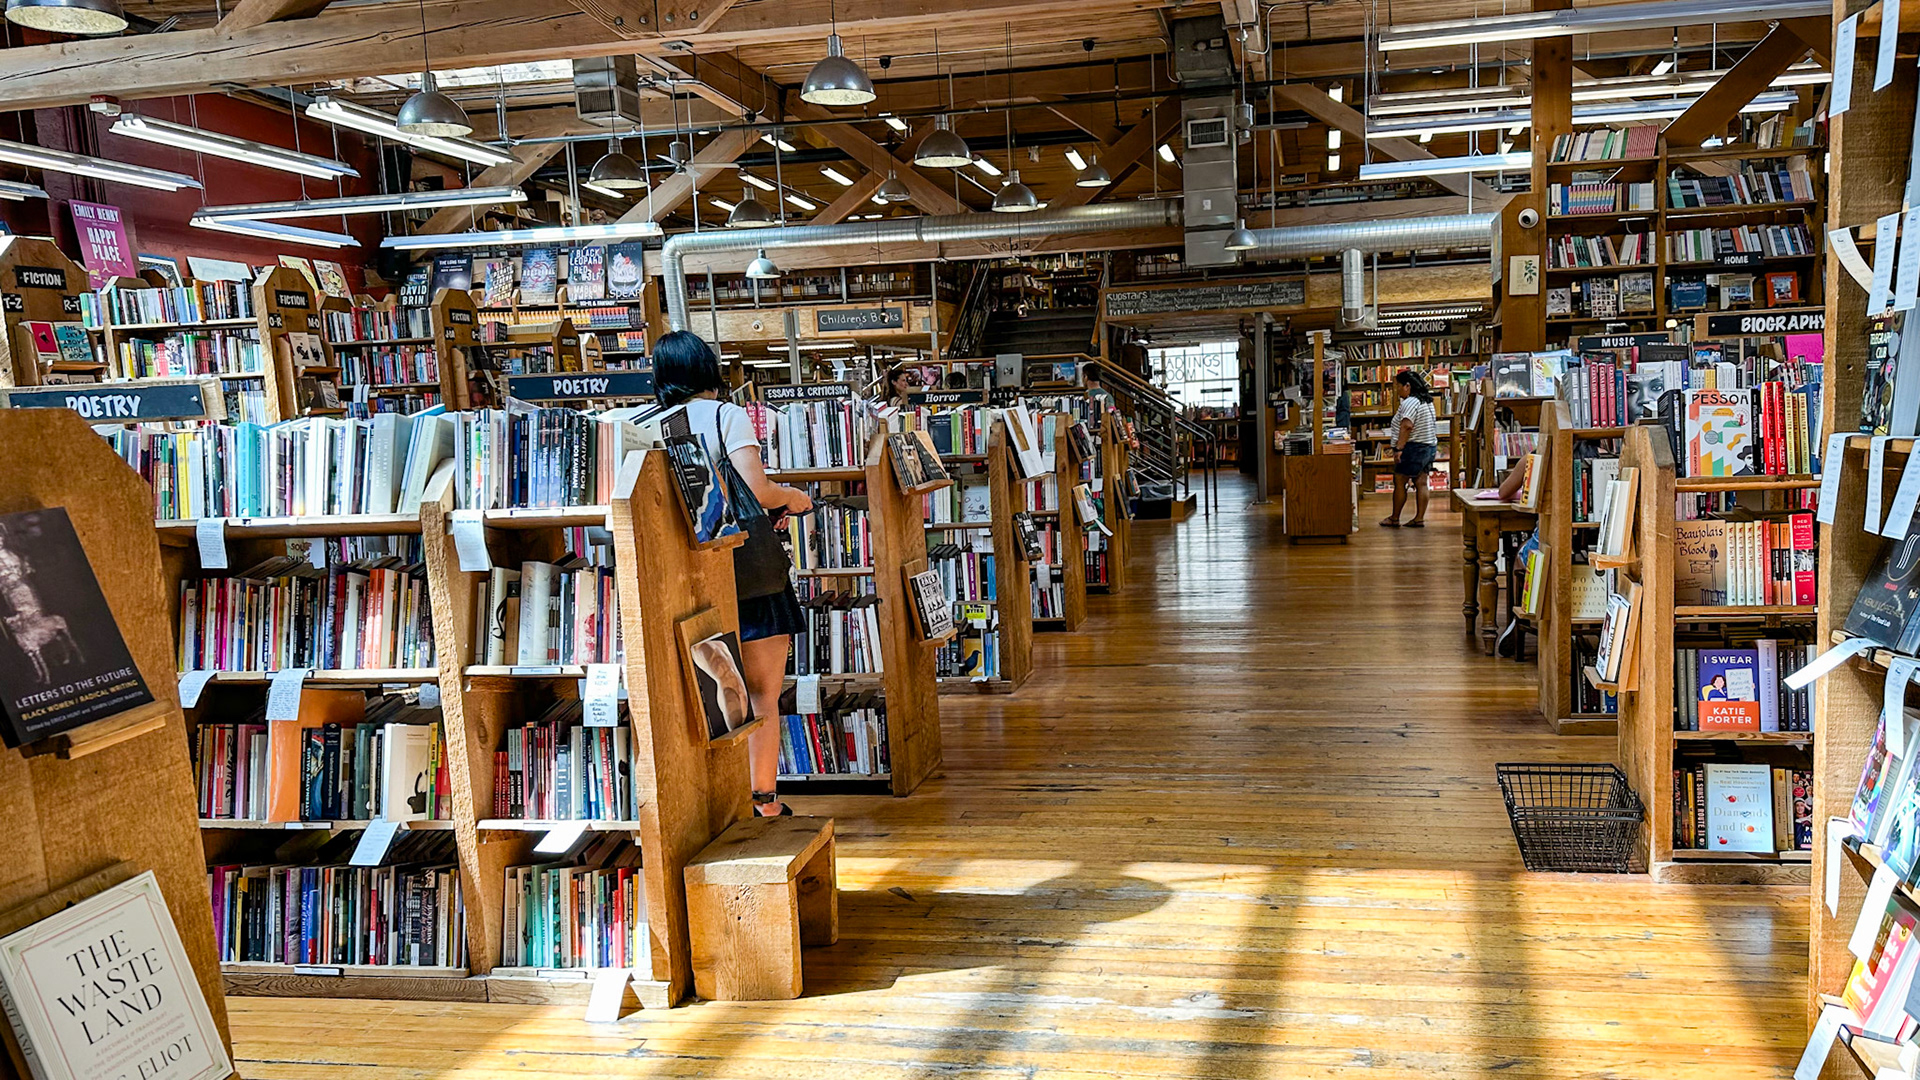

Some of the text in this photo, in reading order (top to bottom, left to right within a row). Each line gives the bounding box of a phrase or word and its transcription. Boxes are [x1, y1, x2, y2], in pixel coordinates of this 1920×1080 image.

[73, 204, 95, 218] EMILY
[96, 207, 119, 222] HENRY
[87, 227, 117, 246] HAPPY
[91, 244, 122, 262] PLACE
[576, 249, 600, 257] BLACK
[1724, 256, 1748, 264] HOME
[570, 256, 602, 266] LEOPARD
[23, 272, 62, 286] FICTION
[400, 285, 426, 296] DAVID
[3, 298, 22, 310] T-Z
[64, 300, 80, 311] R-T
[280, 294, 306, 306] FICTION
[402, 295, 424, 306] BRIN
[452, 312, 470, 322] FICTION
[820, 311, 900, 325] Children's Bks
[1741, 314, 1825, 332] BIOGRAPHY
[1405, 320, 1446, 334] COOKING
[1602, 337, 1636, 348] MUSIC
[1876, 346, 1887, 358] CLUB
[1150, 354, 1220, 369] EADINGS
[553, 378, 609, 394] POETRY
[768, 385, 848, 398] ESSAYS & CRITICISM
[925, 394, 960, 402] Horror
[1692, 394, 1748, 404] PESSOA
[66, 396, 141, 418] POETRY
[1676, 523, 1723, 544] Beaujolais
[1680, 542, 1708, 556] Blood
[1712, 656, 1752, 664] SWEAR
[16, 666, 133, 709] LETTERS TO THE FUTURE
[22, 707, 46, 721] BLACK
[48, 700, 75, 714] WOMEN
[79, 689, 109, 703] RADICAL
[109, 679, 138, 694] WRITING
[26, 722, 43, 732] Edited
[44, 720, 50, 728] by
[51, 714, 65, 725] ERICA
[66, 710, 81, 721] HUNT
[91, 703, 107, 713] DAWN
[108, 698, 124, 709] LUNDY
[124, 690, 144, 704] MARTIN
[1707, 716, 1752, 724] PORTER
[1697, 770, 1705, 828] THE SUNSET ROUTE
[1744, 794, 1759, 803] All
[1717, 823, 1735, 831] and
[66, 930, 132, 977] THE
[57, 948, 163, 1017] WASTE
[80, 983, 162, 1046] LAND
[14, 1022, 34, 1056] LAND
[101, 1033, 129, 1054] FACSIMILE
[135, 1011, 167, 1033] TRANSCRIPT
[93, 1060, 104, 1071] THE
[105, 1044, 133, 1064] ORIGINAL
[133, 1034, 152, 1048] DRAFTS
[153, 1013, 185, 1037] INCLUDING
[104, 1049, 143, 1075] ANNOTATIONS
[143, 1044, 150, 1052] OF
[151, 1035, 165, 1047] EZRA
[166, 1023, 186, 1038] POUND
[138, 1034, 191, 1080] ELIOT
